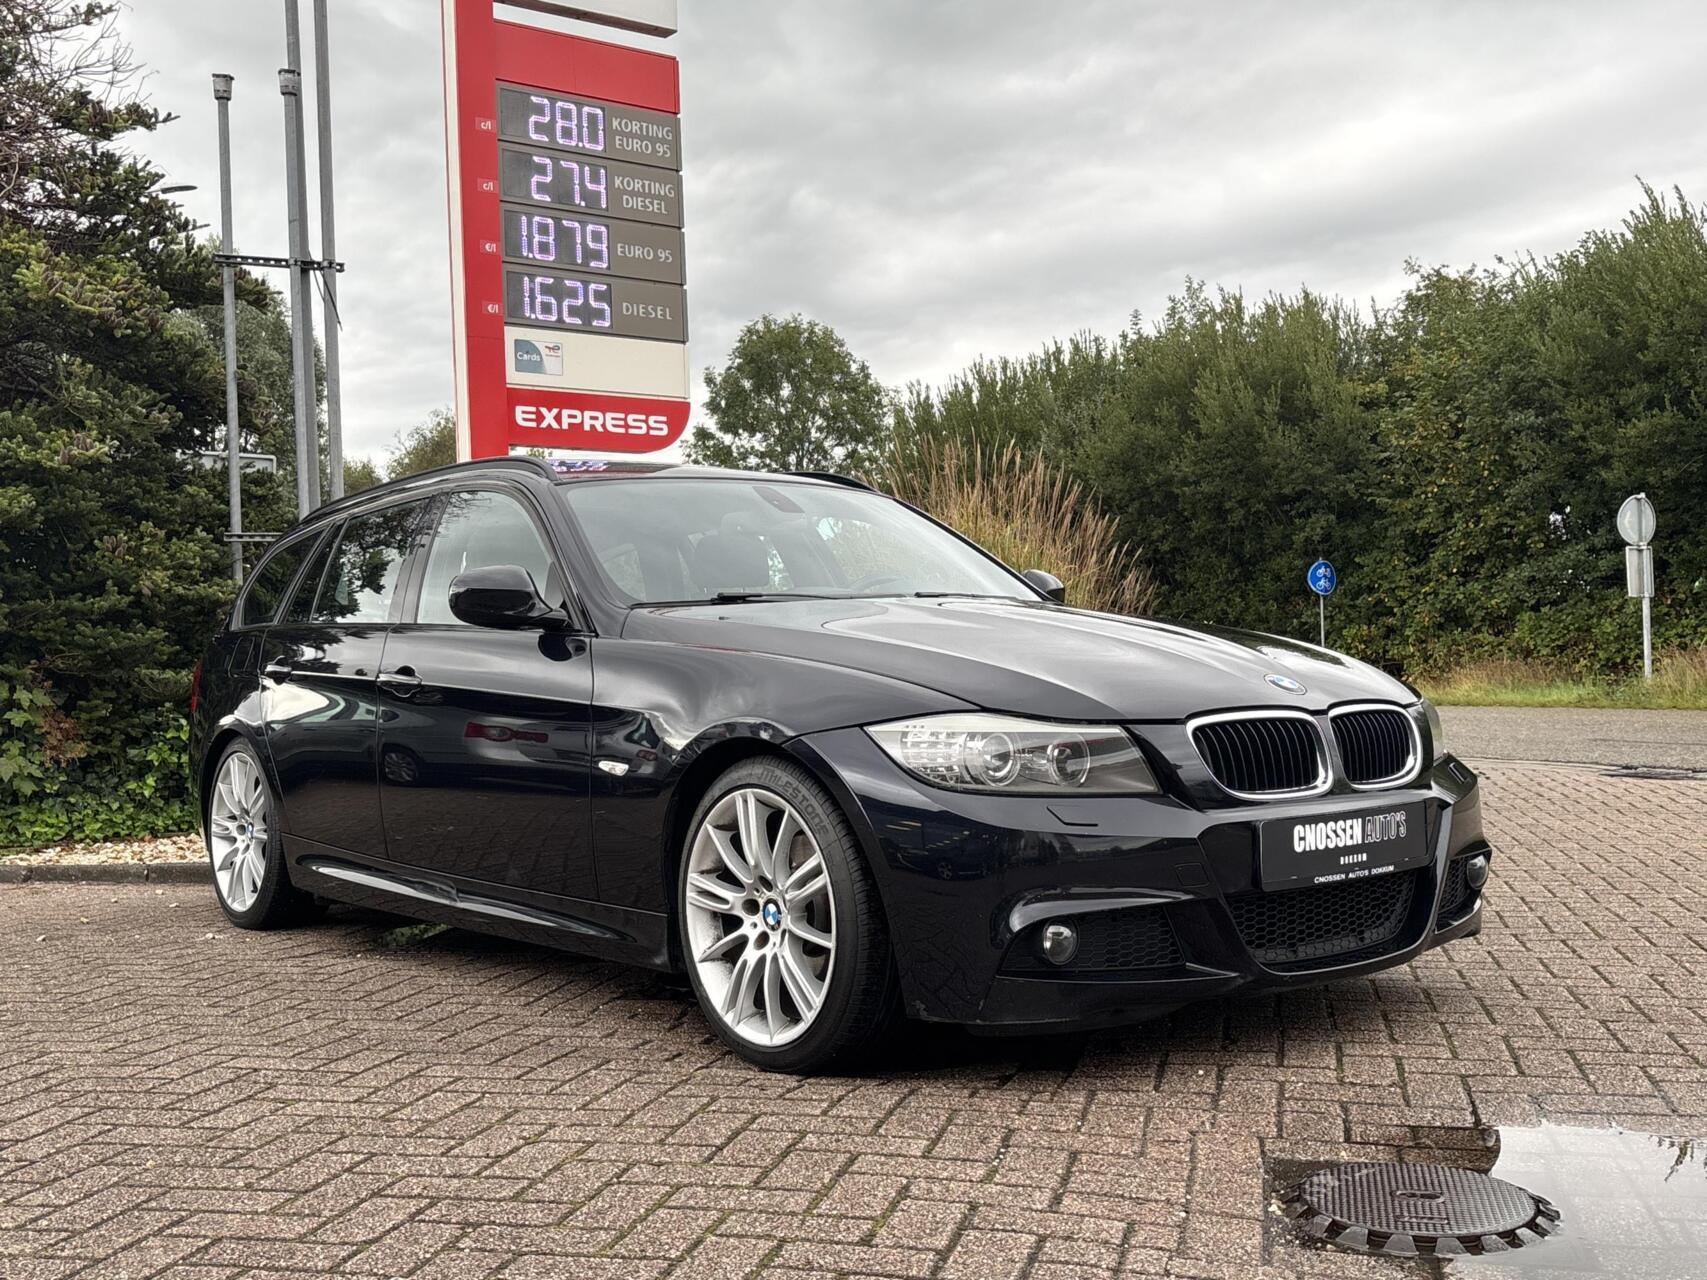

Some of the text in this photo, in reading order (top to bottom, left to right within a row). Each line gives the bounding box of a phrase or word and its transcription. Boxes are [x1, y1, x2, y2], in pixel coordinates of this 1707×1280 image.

[528, 95, 604, 151] 28.0
[612, 117, 673, 140] KORTING
[615, 135, 671, 157] EURO 95
[530, 155, 607, 209] 27.4
[614, 175, 675, 198] KORTING
[622, 194, 668, 215] DIESEL
[521, 215, 608, 268] 1.879
[617, 243, 673, 263] EURO 95
[523, 275, 611, 327] 1.625
[622, 302, 673, 320] DIESEL
[516, 351, 541, 361] Cards
[514, 405, 669, 436] EXPRESS
[1293, 810, 1407, 853] CNOSSEN AUTO'S
[1314, 873, 1345, 884] CNOSSEN
